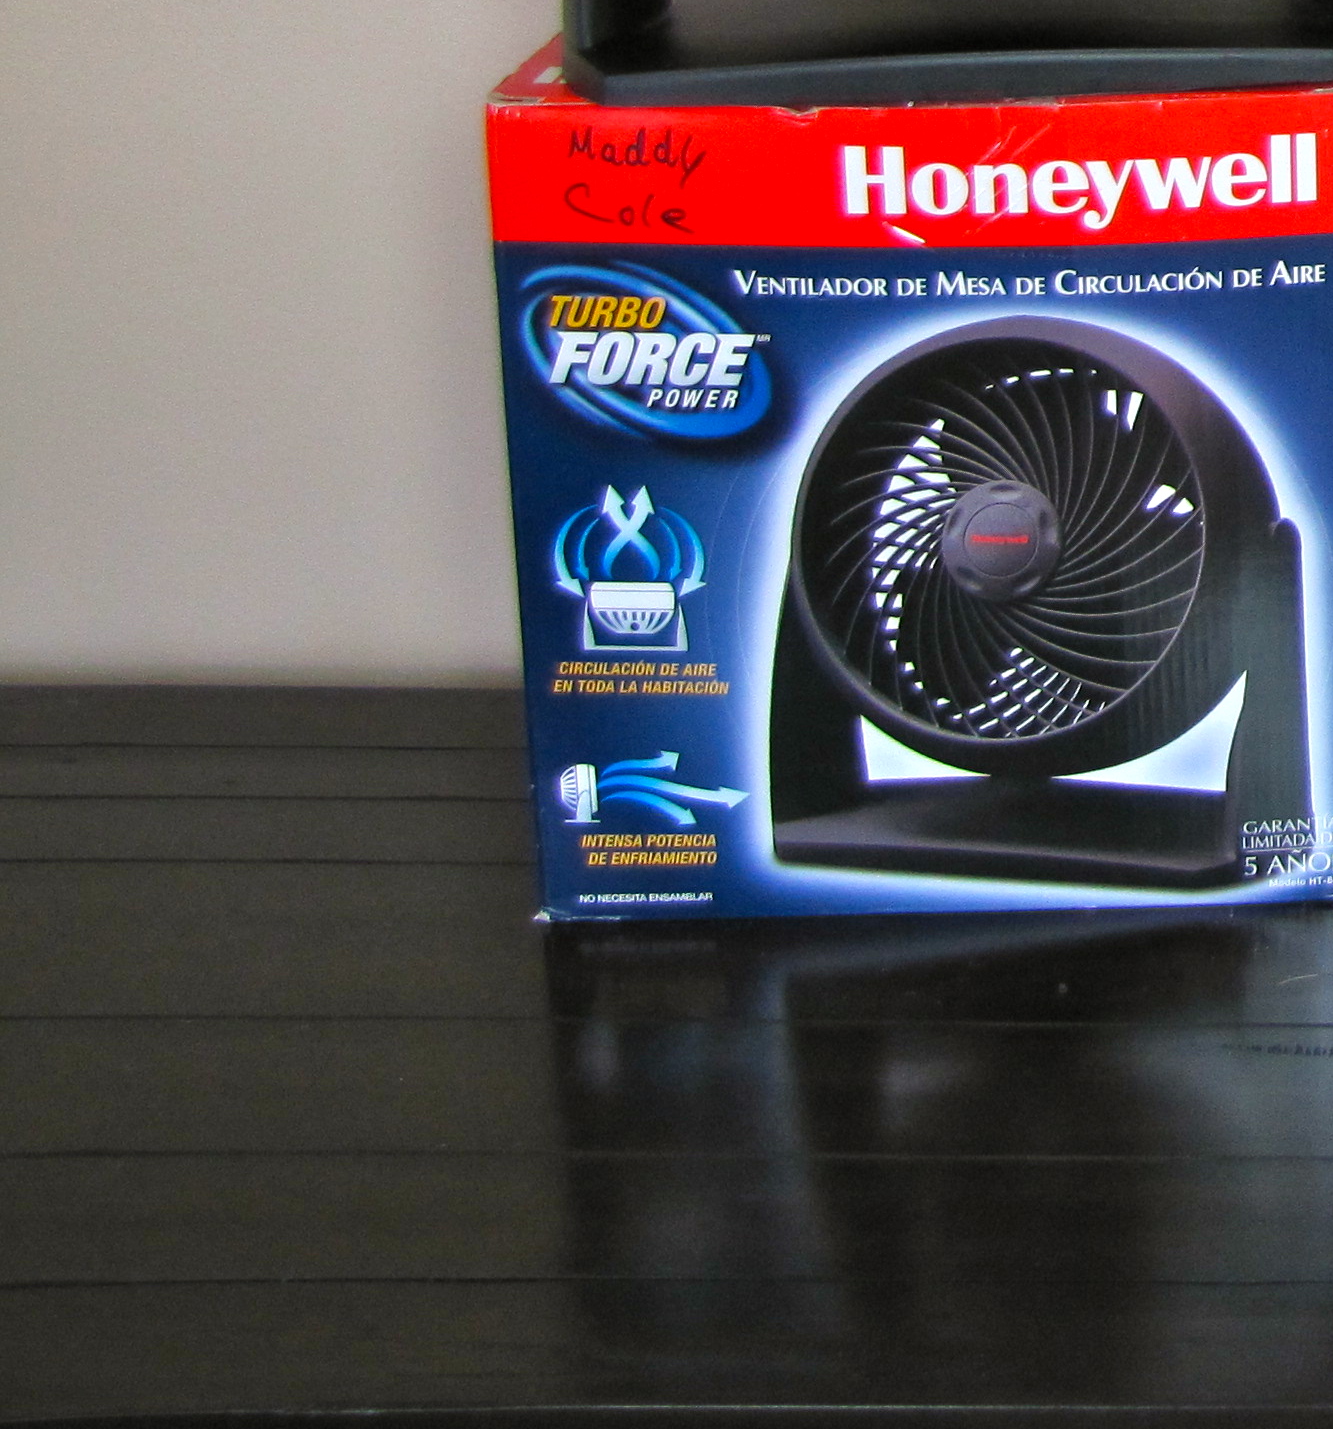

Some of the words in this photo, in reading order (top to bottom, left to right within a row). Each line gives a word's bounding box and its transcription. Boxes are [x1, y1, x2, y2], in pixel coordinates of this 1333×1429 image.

[567, 125, 707, 188] Maddy
[843, 132, 1318, 229] Honeywell
[563, 182, 695, 234] Cole
[734, 269, 888, 296] VENTILADOR
[897, 277, 927, 296] DE
[936, 270, 1006, 296] MESA
[1015, 276, 1046, 296] DE
[1054, 266, 1223, 296] CIRCULACIÓN
[1232, 267, 1263, 289] DE
[1269, 259, 1326, 287] AIRE
[548, 294, 667, 330] TURBO
[548, 330, 757, 387] FORCE
[646, 387, 740, 410] POWER
[559, 660, 656, 676] CIRCULACIÓN
[659, 662, 680, 676] DE
[683, 663, 718, 677] AIRE
[553, 679, 574, 693] EN
[577, 679, 615, 693] TODA
[619, 680, 638, 694] LA
[641, 679, 730, 695] HABITACIÓN
[581, 833, 643, 848] INTENSA
[646, 833, 717, 847] POTENCIA
[1242, 833, 1317, 849] LIMITADA
[588, 851, 608, 866] DE
[611, 851, 718, 866] ENFRIAMIENTO
[1244, 855, 1258, 876] 5
[579, 893, 596, 903] NO
[597, 893, 648, 903] NECESITA
[649, 892, 714, 902] ENSAMBLAR
